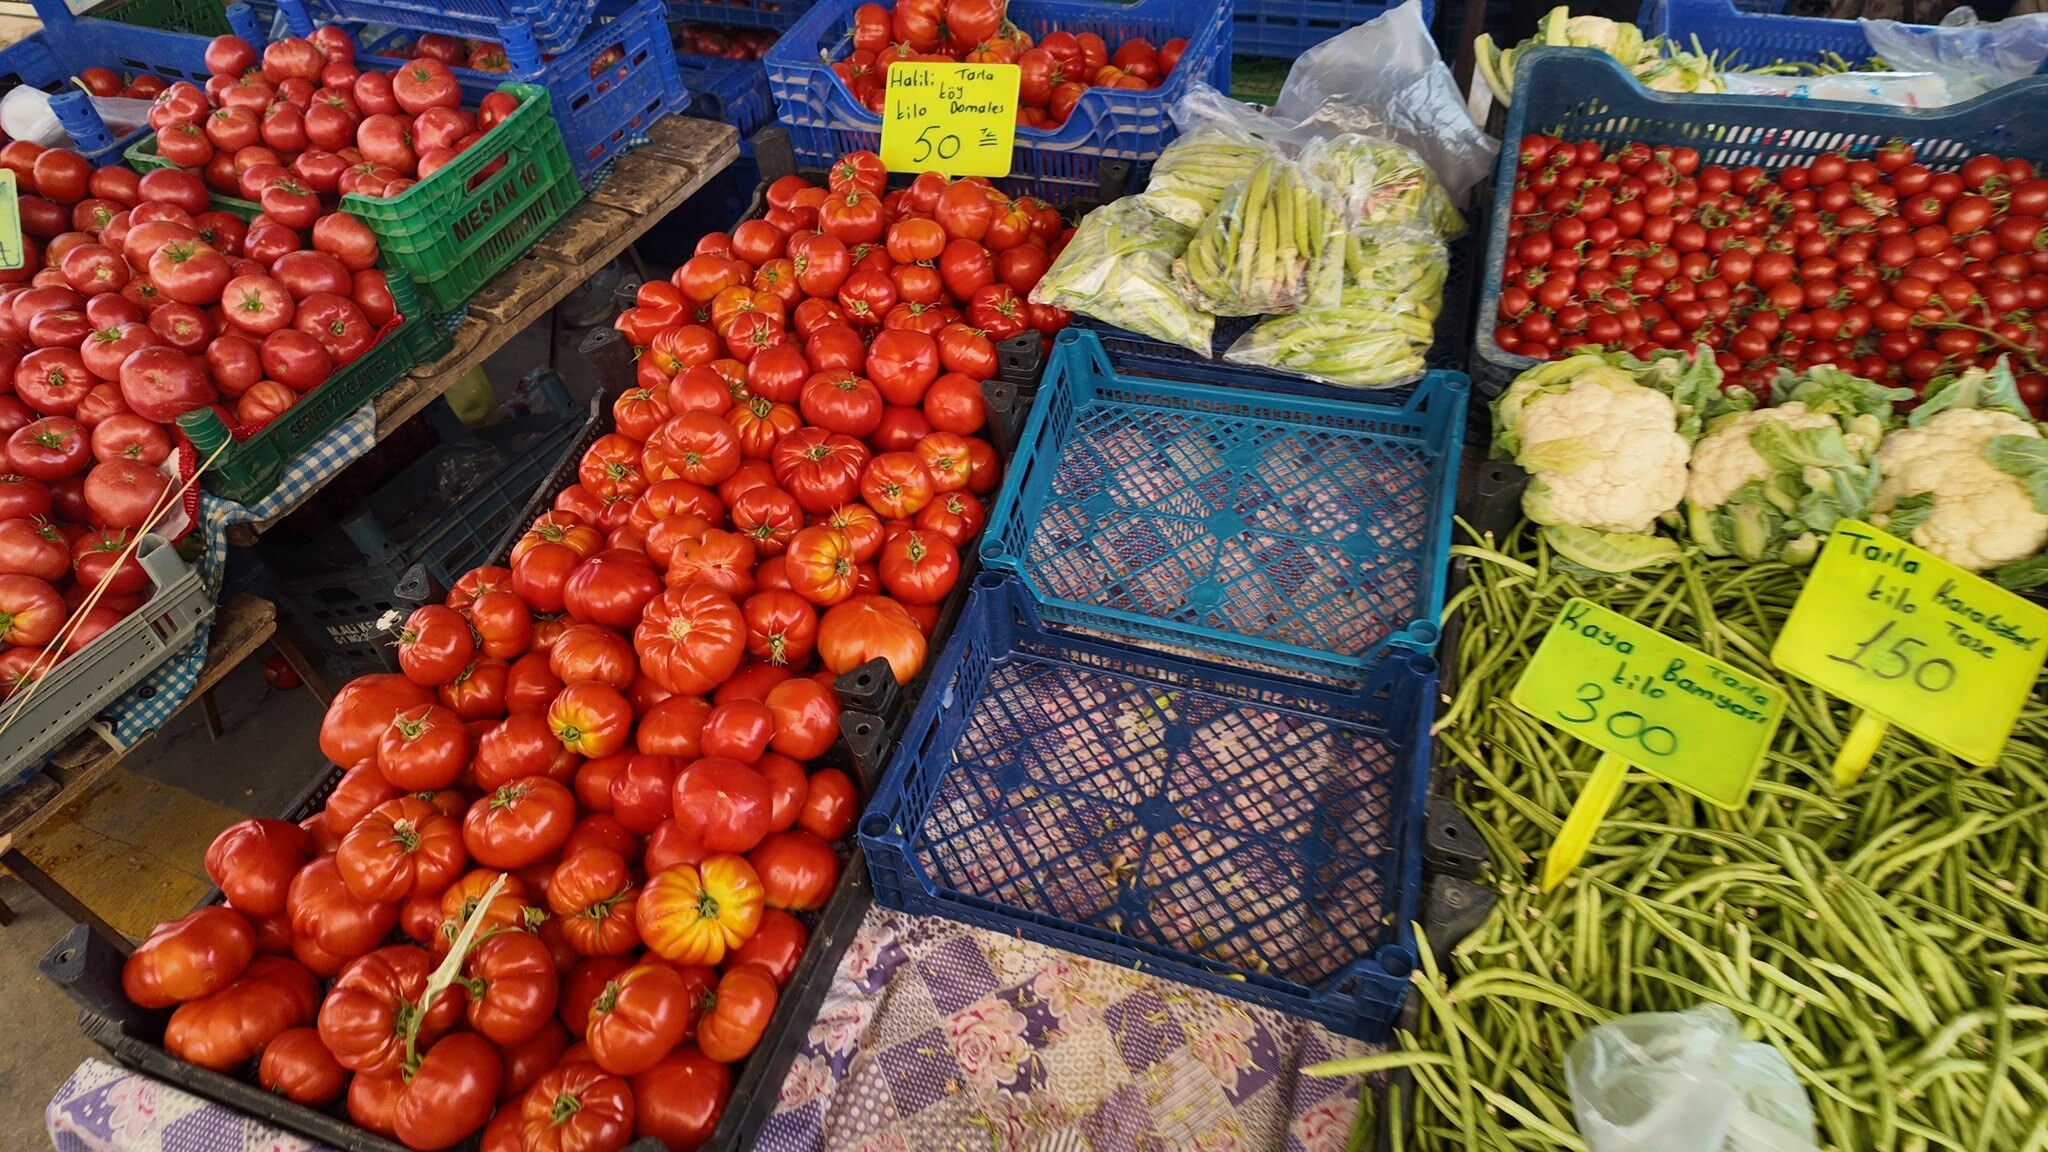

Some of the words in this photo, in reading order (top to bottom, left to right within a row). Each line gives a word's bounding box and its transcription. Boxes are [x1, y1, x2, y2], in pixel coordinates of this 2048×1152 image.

[955, 68, 994, 81] Tarla
[912, 125, 961, 163] 50
[452, 176, 519, 244] MESAN
[519, 161, 537, 189] 10
[1840, 531, 1920, 574] Tarla
[1827, 620, 1957, 693] 150
[1707, 664, 1769, 706] Tarla
[1557, 681, 1678, 757] 300
